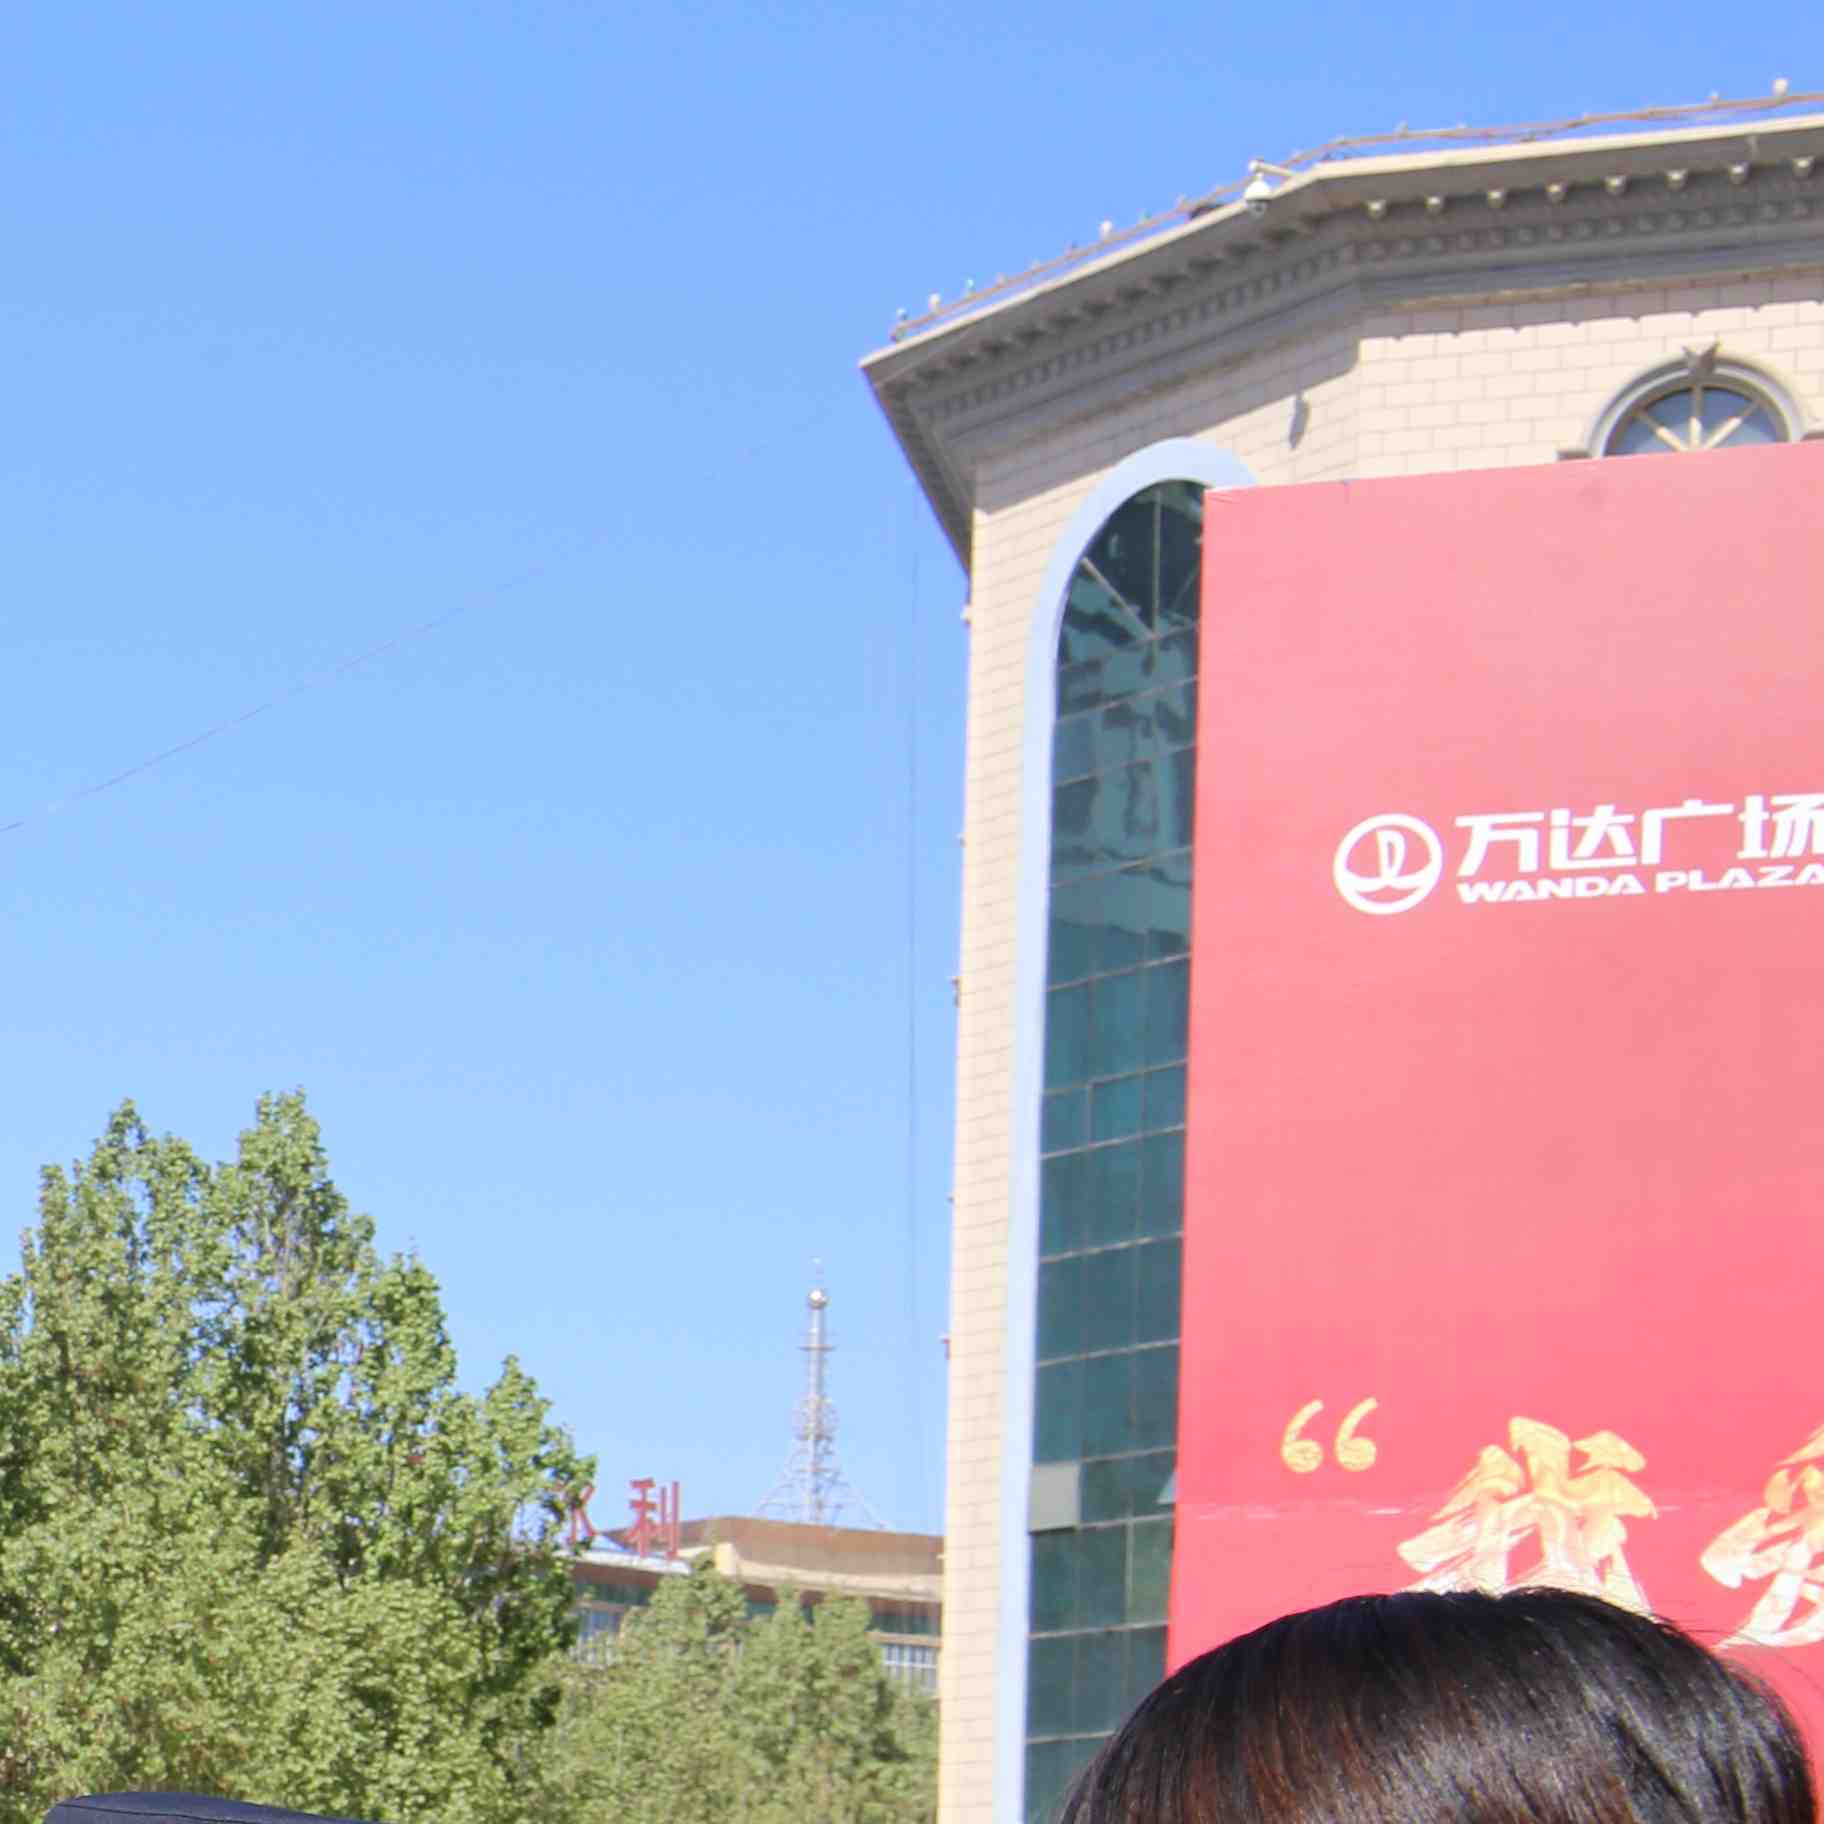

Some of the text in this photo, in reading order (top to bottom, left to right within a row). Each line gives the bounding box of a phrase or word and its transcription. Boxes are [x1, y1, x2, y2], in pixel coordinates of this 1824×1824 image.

[1455, 793, 1824, 877] 万达广场
[1456, 863, 1824, 904] WANDA PLAZA
